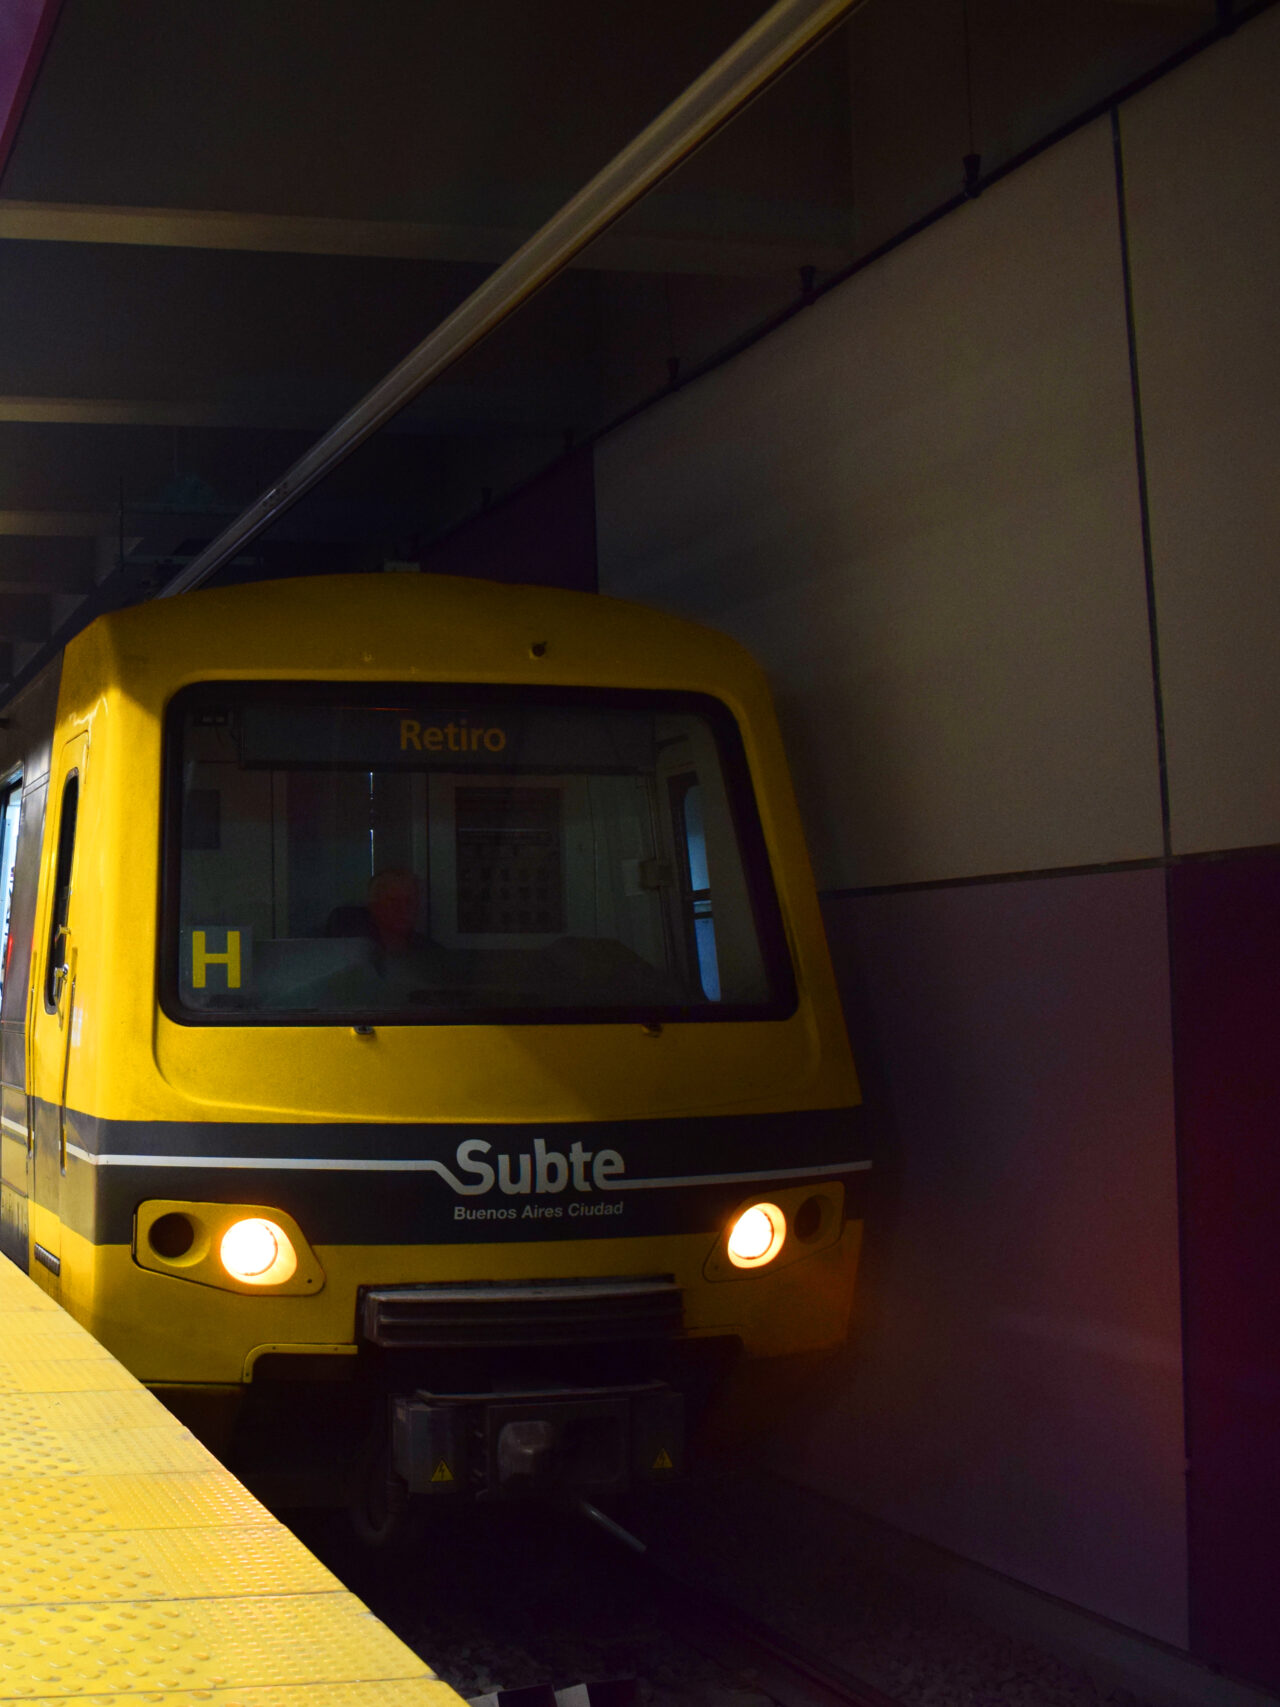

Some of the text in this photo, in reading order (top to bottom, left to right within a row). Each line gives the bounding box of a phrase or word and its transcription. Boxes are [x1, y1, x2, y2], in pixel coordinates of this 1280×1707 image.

[400, 719, 506, 752] Retiro
[192, 931, 240, 988] H
[456, 1138, 625, 1196] Subte
[453, 1201, 624, 1220] Buenos Aires Ciudad
